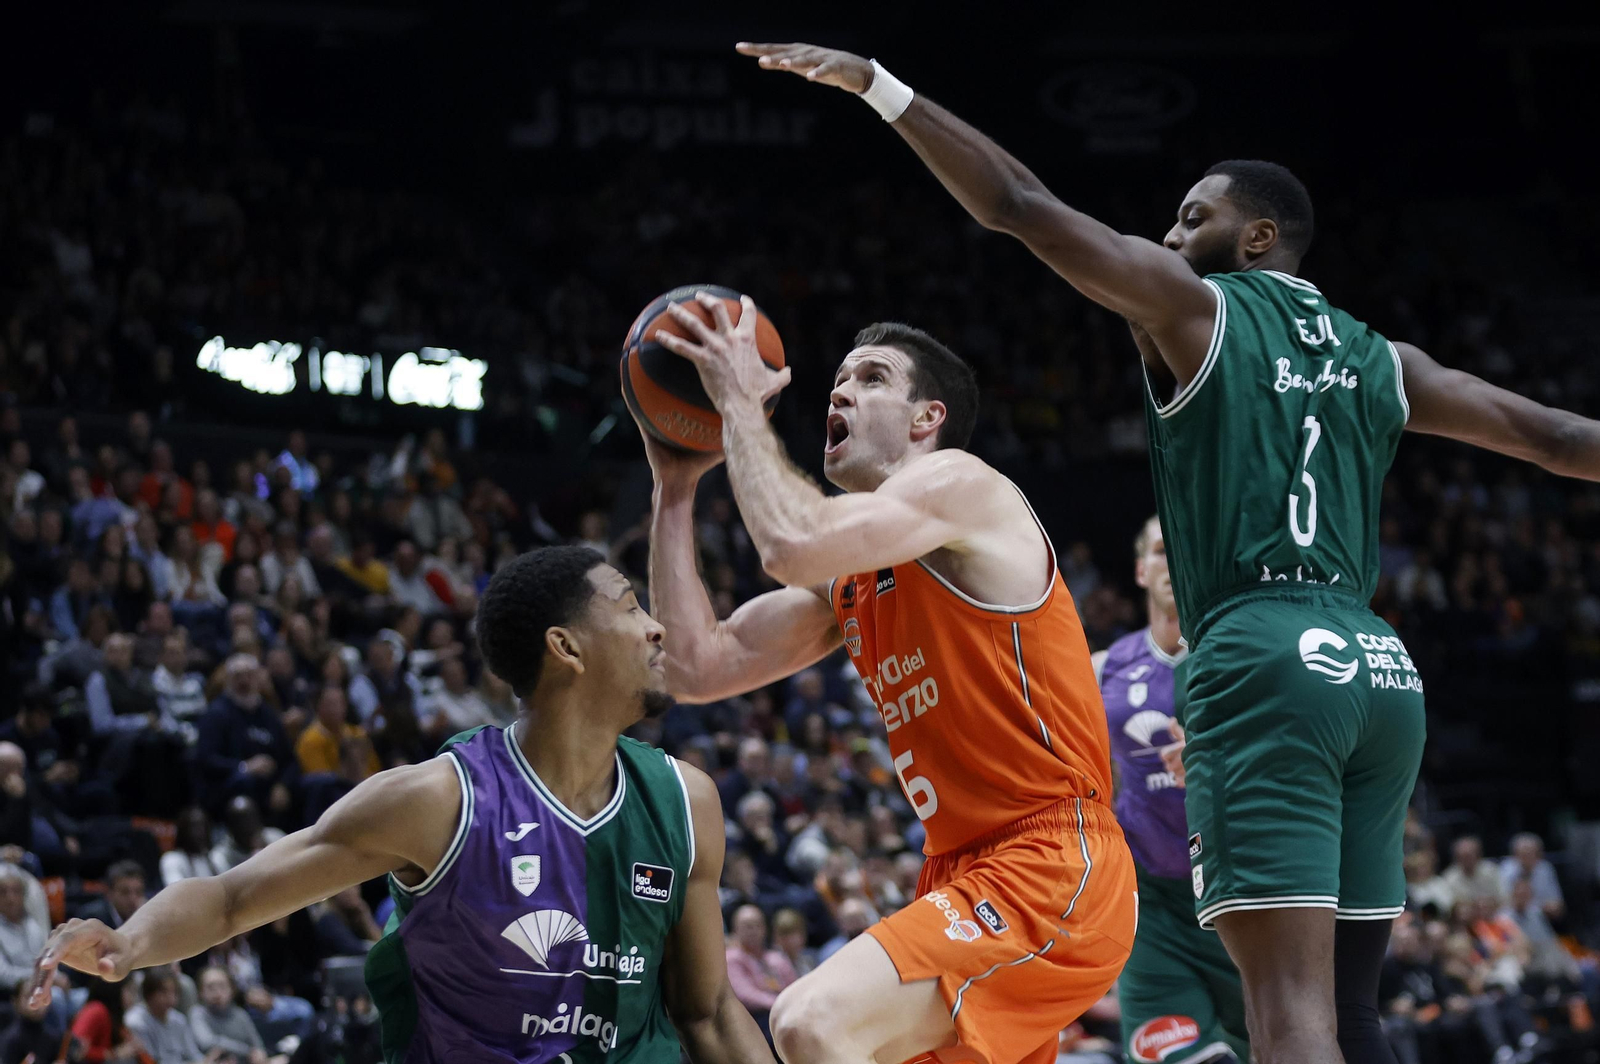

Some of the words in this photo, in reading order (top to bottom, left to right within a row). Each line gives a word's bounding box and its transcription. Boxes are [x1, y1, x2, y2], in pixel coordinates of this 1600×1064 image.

[574, 99, 816, 149] popular
[1289, 415, 1321, 547] 3
[1356, 632, 1408, 655] COST
[902, 647, 926, 676] del
[1365, 652, 1401, 670] DEL
[1370, 669, 1424, 694] MÁLAG
[635, 873, 651, 886] liga
[635, 884, 668, 898] endesa
[979, 905, 998, 927] acb
